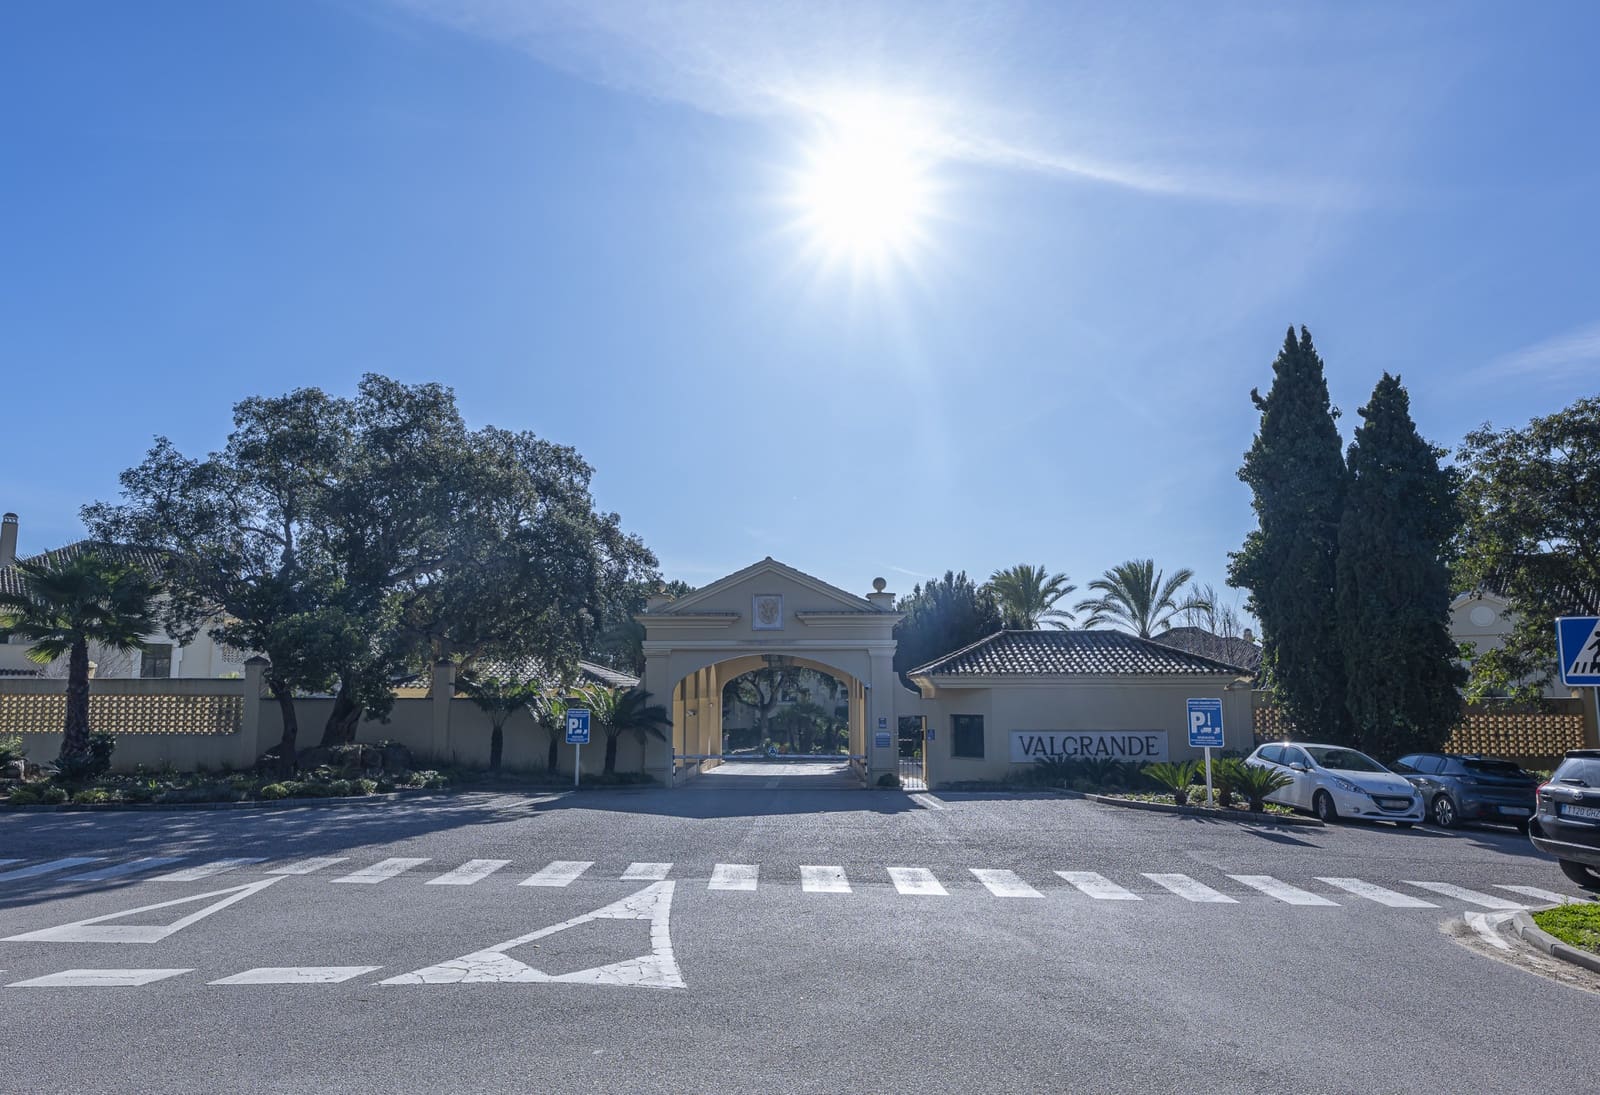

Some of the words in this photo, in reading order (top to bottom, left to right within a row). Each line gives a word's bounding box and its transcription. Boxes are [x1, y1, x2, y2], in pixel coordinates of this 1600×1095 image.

[568, 718, 579, 734] P
[1190, 711, 1206, 733] P
[1018, 735, 1160, 757] VALGRANDE
